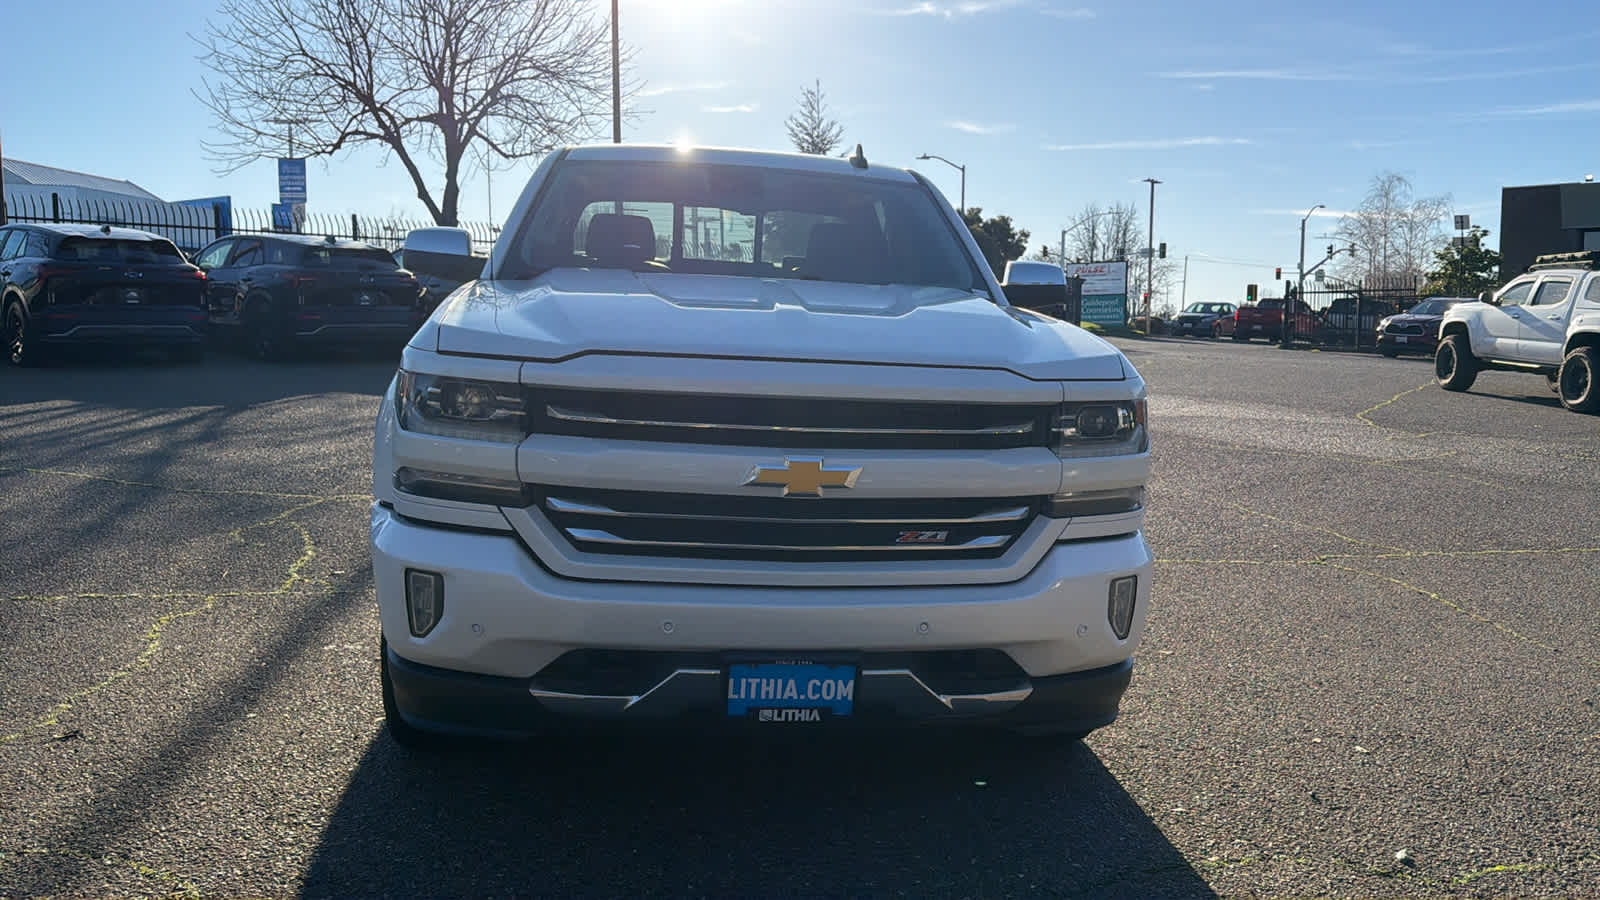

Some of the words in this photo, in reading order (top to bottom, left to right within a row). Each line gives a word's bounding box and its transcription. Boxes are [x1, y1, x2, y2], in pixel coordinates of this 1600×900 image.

[895, 530, 949, 543] Z71
[728, 678, 855, 701] LITHIA.COM
[773, 708, 821, 722] LITHIA
